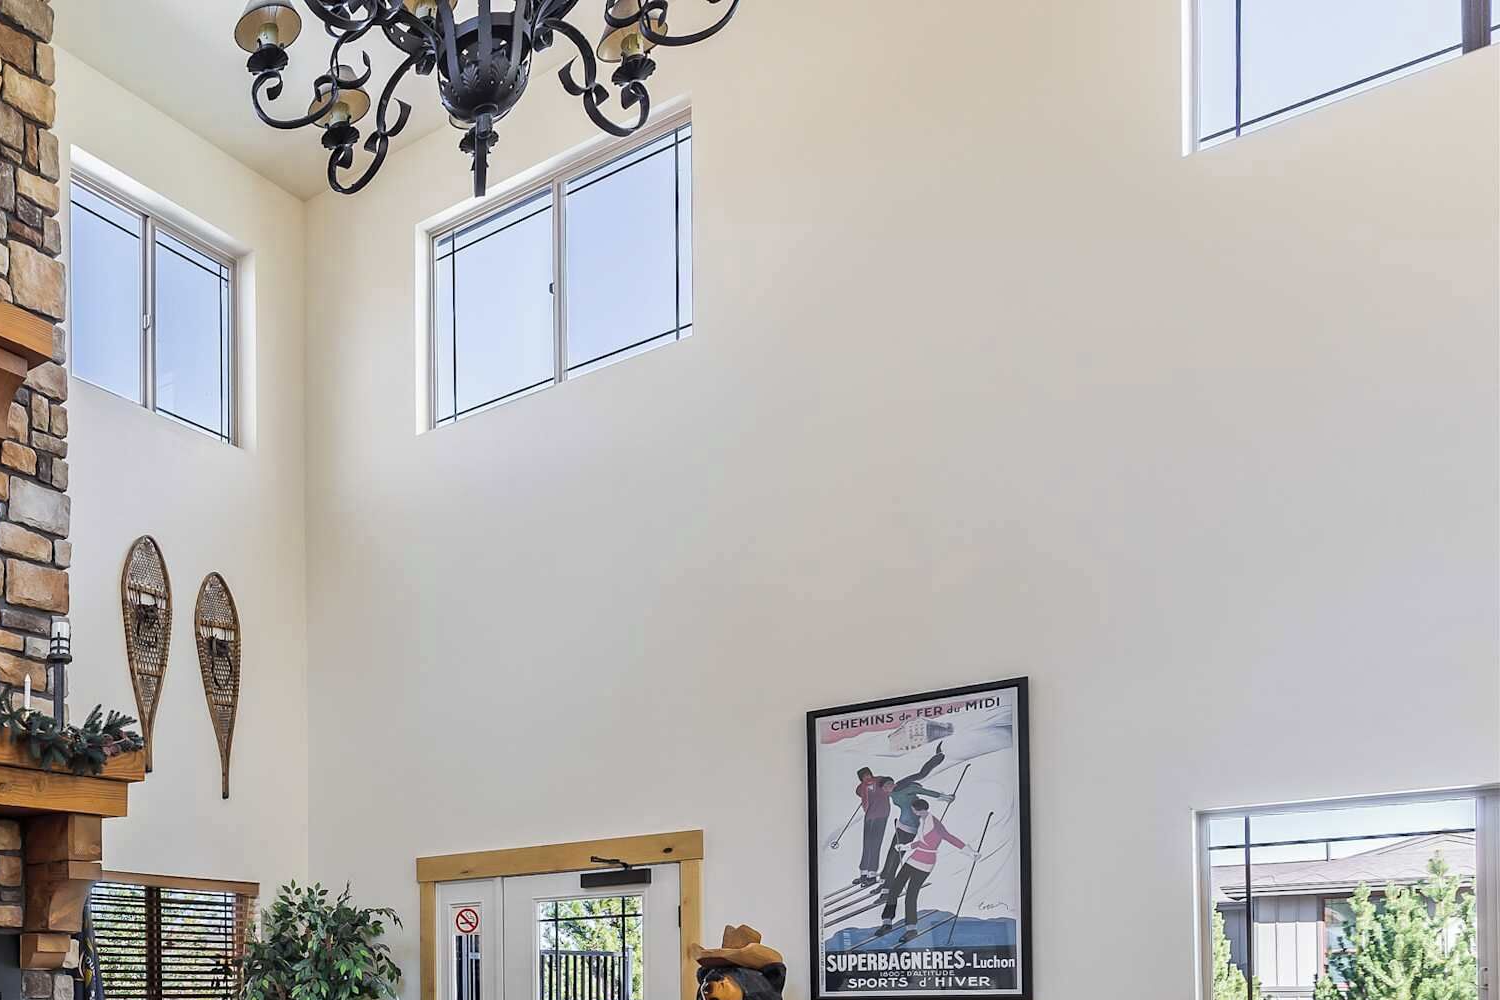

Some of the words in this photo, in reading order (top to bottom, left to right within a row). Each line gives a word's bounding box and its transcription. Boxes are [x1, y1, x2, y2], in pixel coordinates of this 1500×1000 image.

[831, 713, 894, 731] CHEMINS
[916, 706, 943, 718] FER
[965, 696, 1000, 711] MIDI
[847, 977, 909, 988] SPORTS
